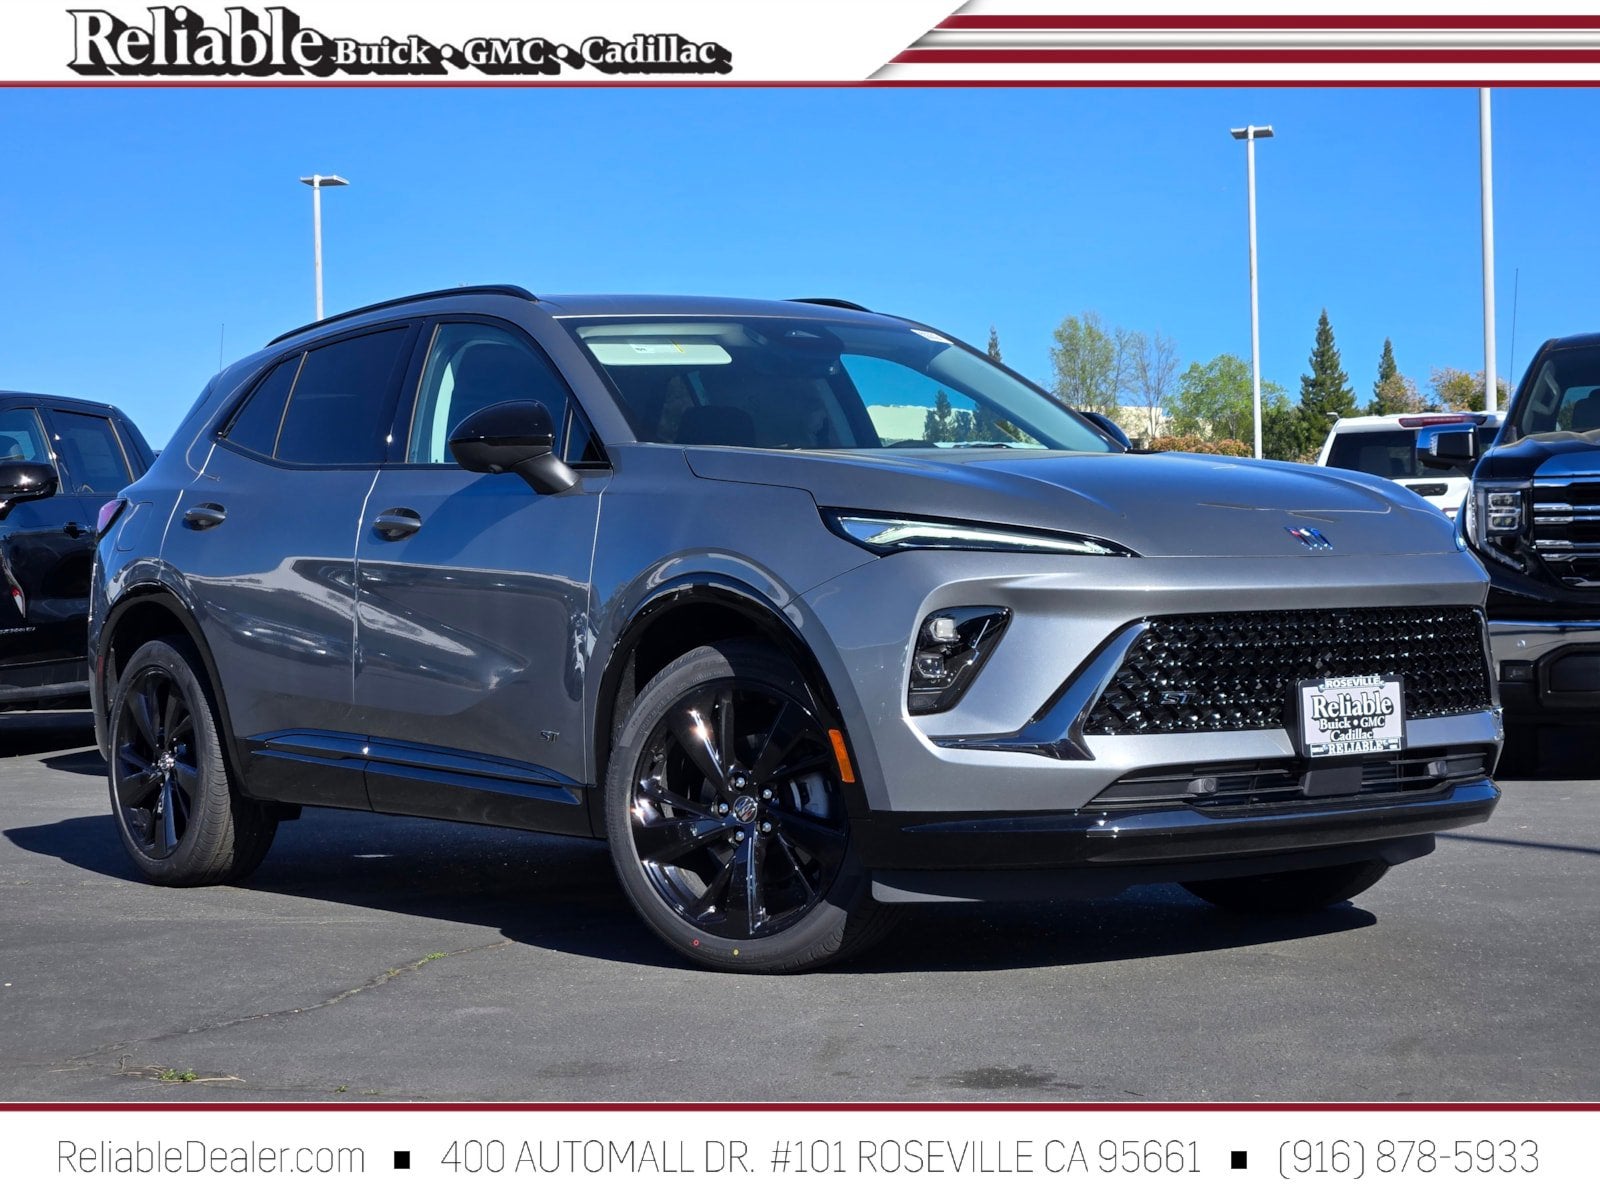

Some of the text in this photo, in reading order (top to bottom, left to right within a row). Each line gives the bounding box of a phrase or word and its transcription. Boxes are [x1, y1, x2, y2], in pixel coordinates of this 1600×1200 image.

[1326, 677, 1380, 688] ROSEVILLE
[1311, 690, 1394, 720] Reliable
[1319, 716, 1386, 731] Buick GMC
[1330, 729, 1374, 742] Cadillac
[1328, 741, 1384, 754] RELIABLE
